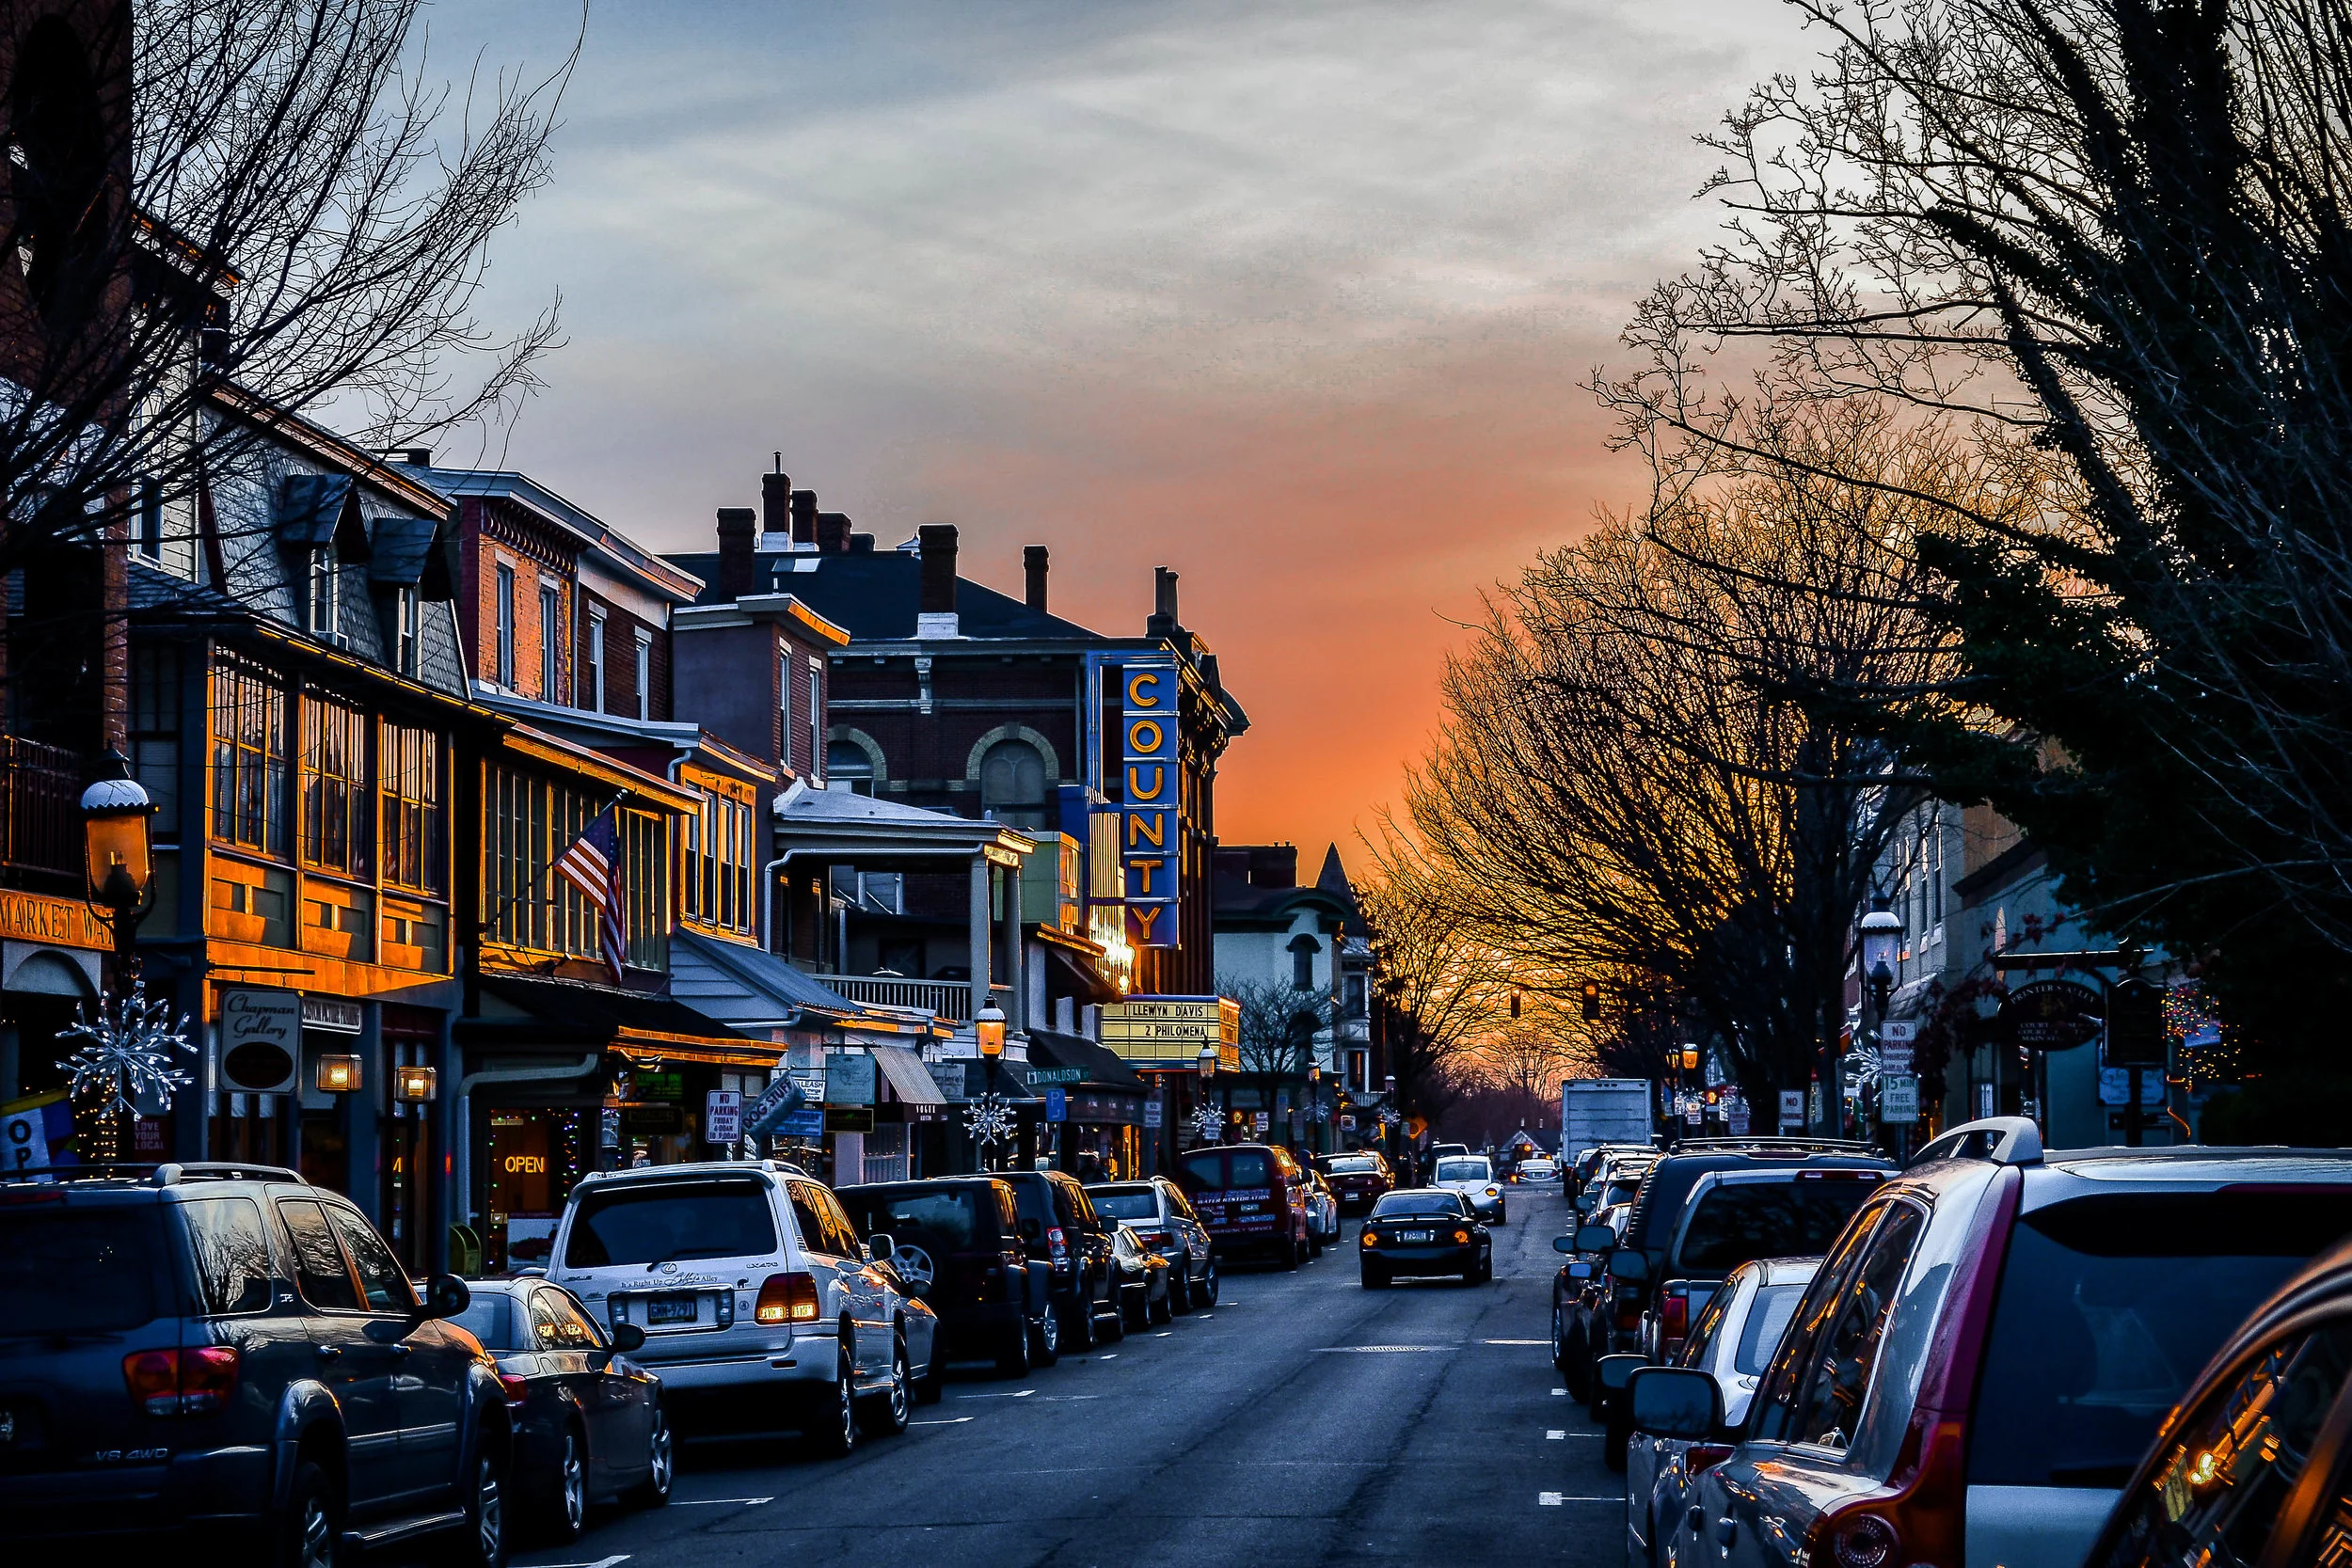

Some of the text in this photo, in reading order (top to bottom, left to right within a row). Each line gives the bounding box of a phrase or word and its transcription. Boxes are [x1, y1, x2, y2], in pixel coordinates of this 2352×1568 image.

[1129, 673, 1163, 940] COUNTY
[0, 896, 73, 940] MARKET
[227, 993, 295, 1019] Chapman
[1133, 1006, 1168, 1016] LLEWYN
[1175, 1006, 1203, 1017] DAVIS
[233, 1015, 286, 1039] Gallery
[1145, 1025, 1205, 1037] 2 PHILOMENA
[1892, 1025, 1906, 1037] NO
[1037, 1069, 1081, 1083] DONALDSON
[1884, 1077, 1915, 1090] 15 MIN
[720, 1094, 730, 1104] NO
[1050, 1091, 1060, 1107] P
[1786, 1097, 1798, 1107] NO
[1890, 1093, 1910, 1103] FREE
[742, 1102, 767, 1129] DOG
[765, 1080, 791, 1106] STUFF
[1884, 1104, 1915, 1115] PARKING
[709, 1105, 739, 1117] PARKING
[135, 1121, 160, 1131] LOVE
[135, 1131, 160, 1140] YOUR
[135, 1140, 165, 1150] LOCAL
[504, 1156, 546, 1174] OPEN
[633, 1279, 651, 1288] Right
[95, 1448, 168, 1462] V8 4WD
